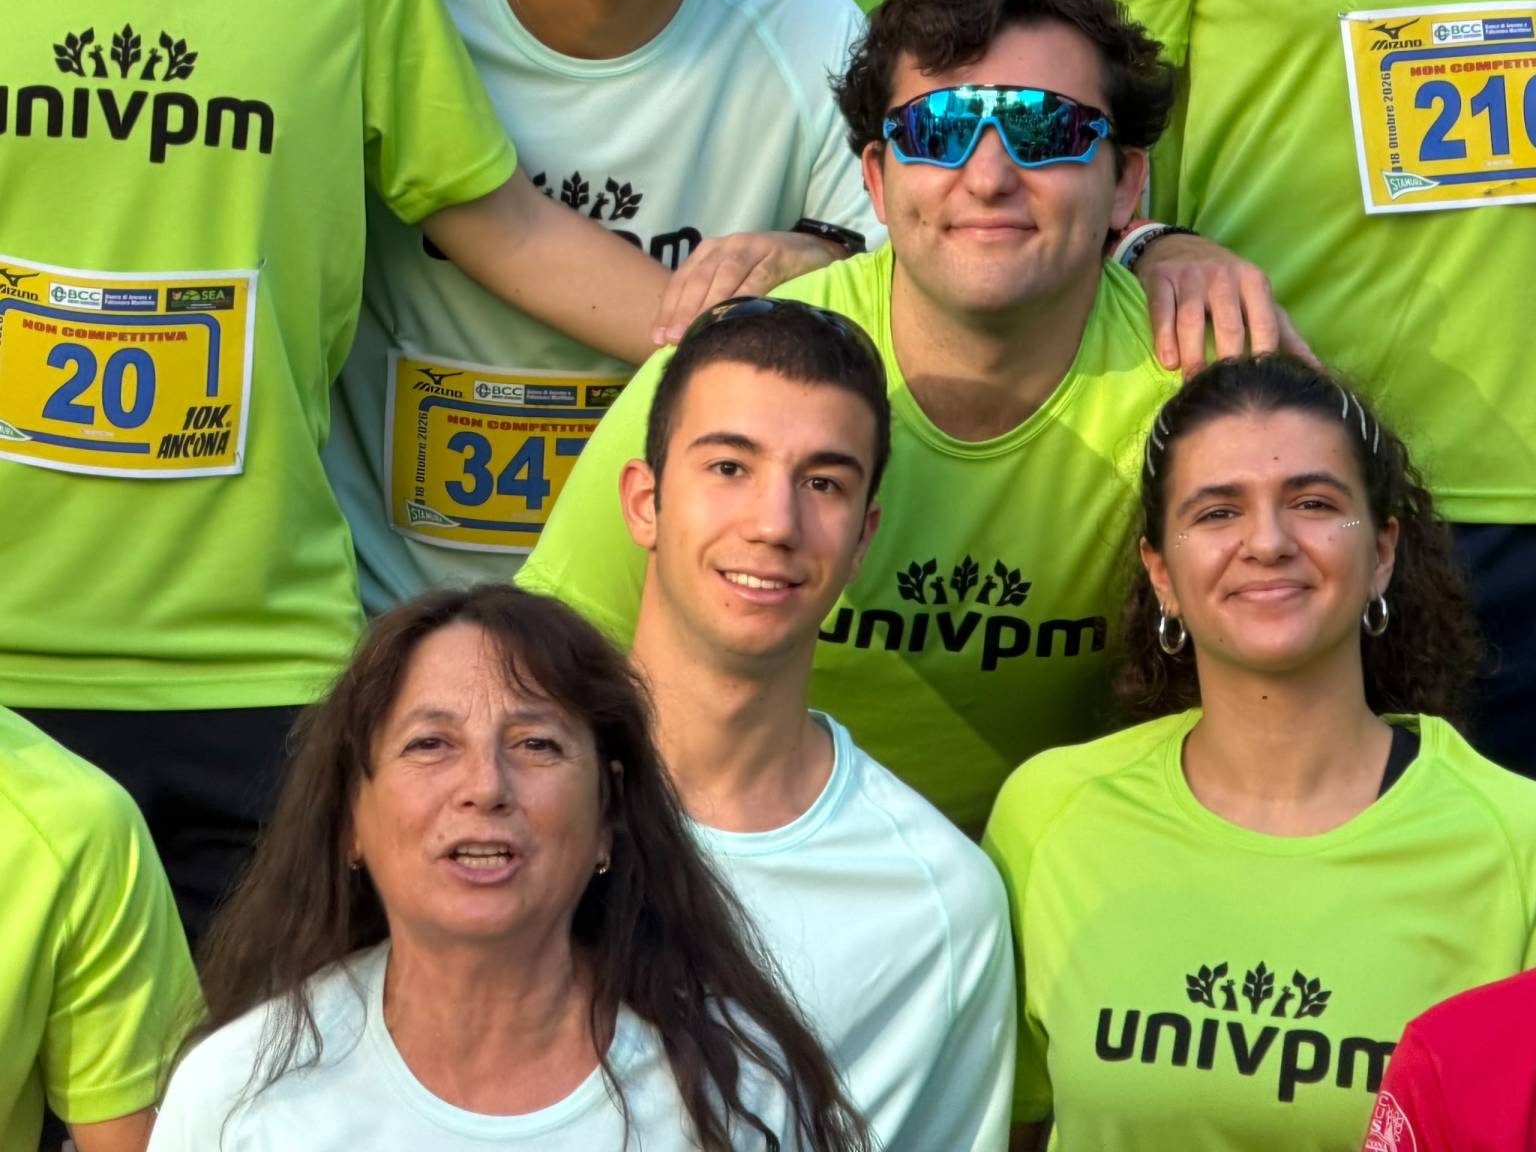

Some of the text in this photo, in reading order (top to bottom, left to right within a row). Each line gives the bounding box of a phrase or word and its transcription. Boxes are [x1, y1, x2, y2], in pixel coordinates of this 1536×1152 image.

[1451, 24, 1482, 35] BCC
[1410, 64, 1446, 77] NON
[1380, 72, 1394, 103] 2026
[67, 288, 101, 301] BCC
[201, 289, 225, 301] SEA
[23, 318, 57, 335] NON
[61, 326, 188, 342] COMPETITIVA
[42, 342, 157, 429] 20
[412, 381, 464, 398] MIZUNO
[492, 386, 523, 397] BCC
[182, 404, 232, 430] 10K
[447, 414, 483, 428] NON
[156, 430, 231, 459] ANCONA
[817, 607, 1107, 671] univpm
[1095, 1008, 1399, 1103] univpm
